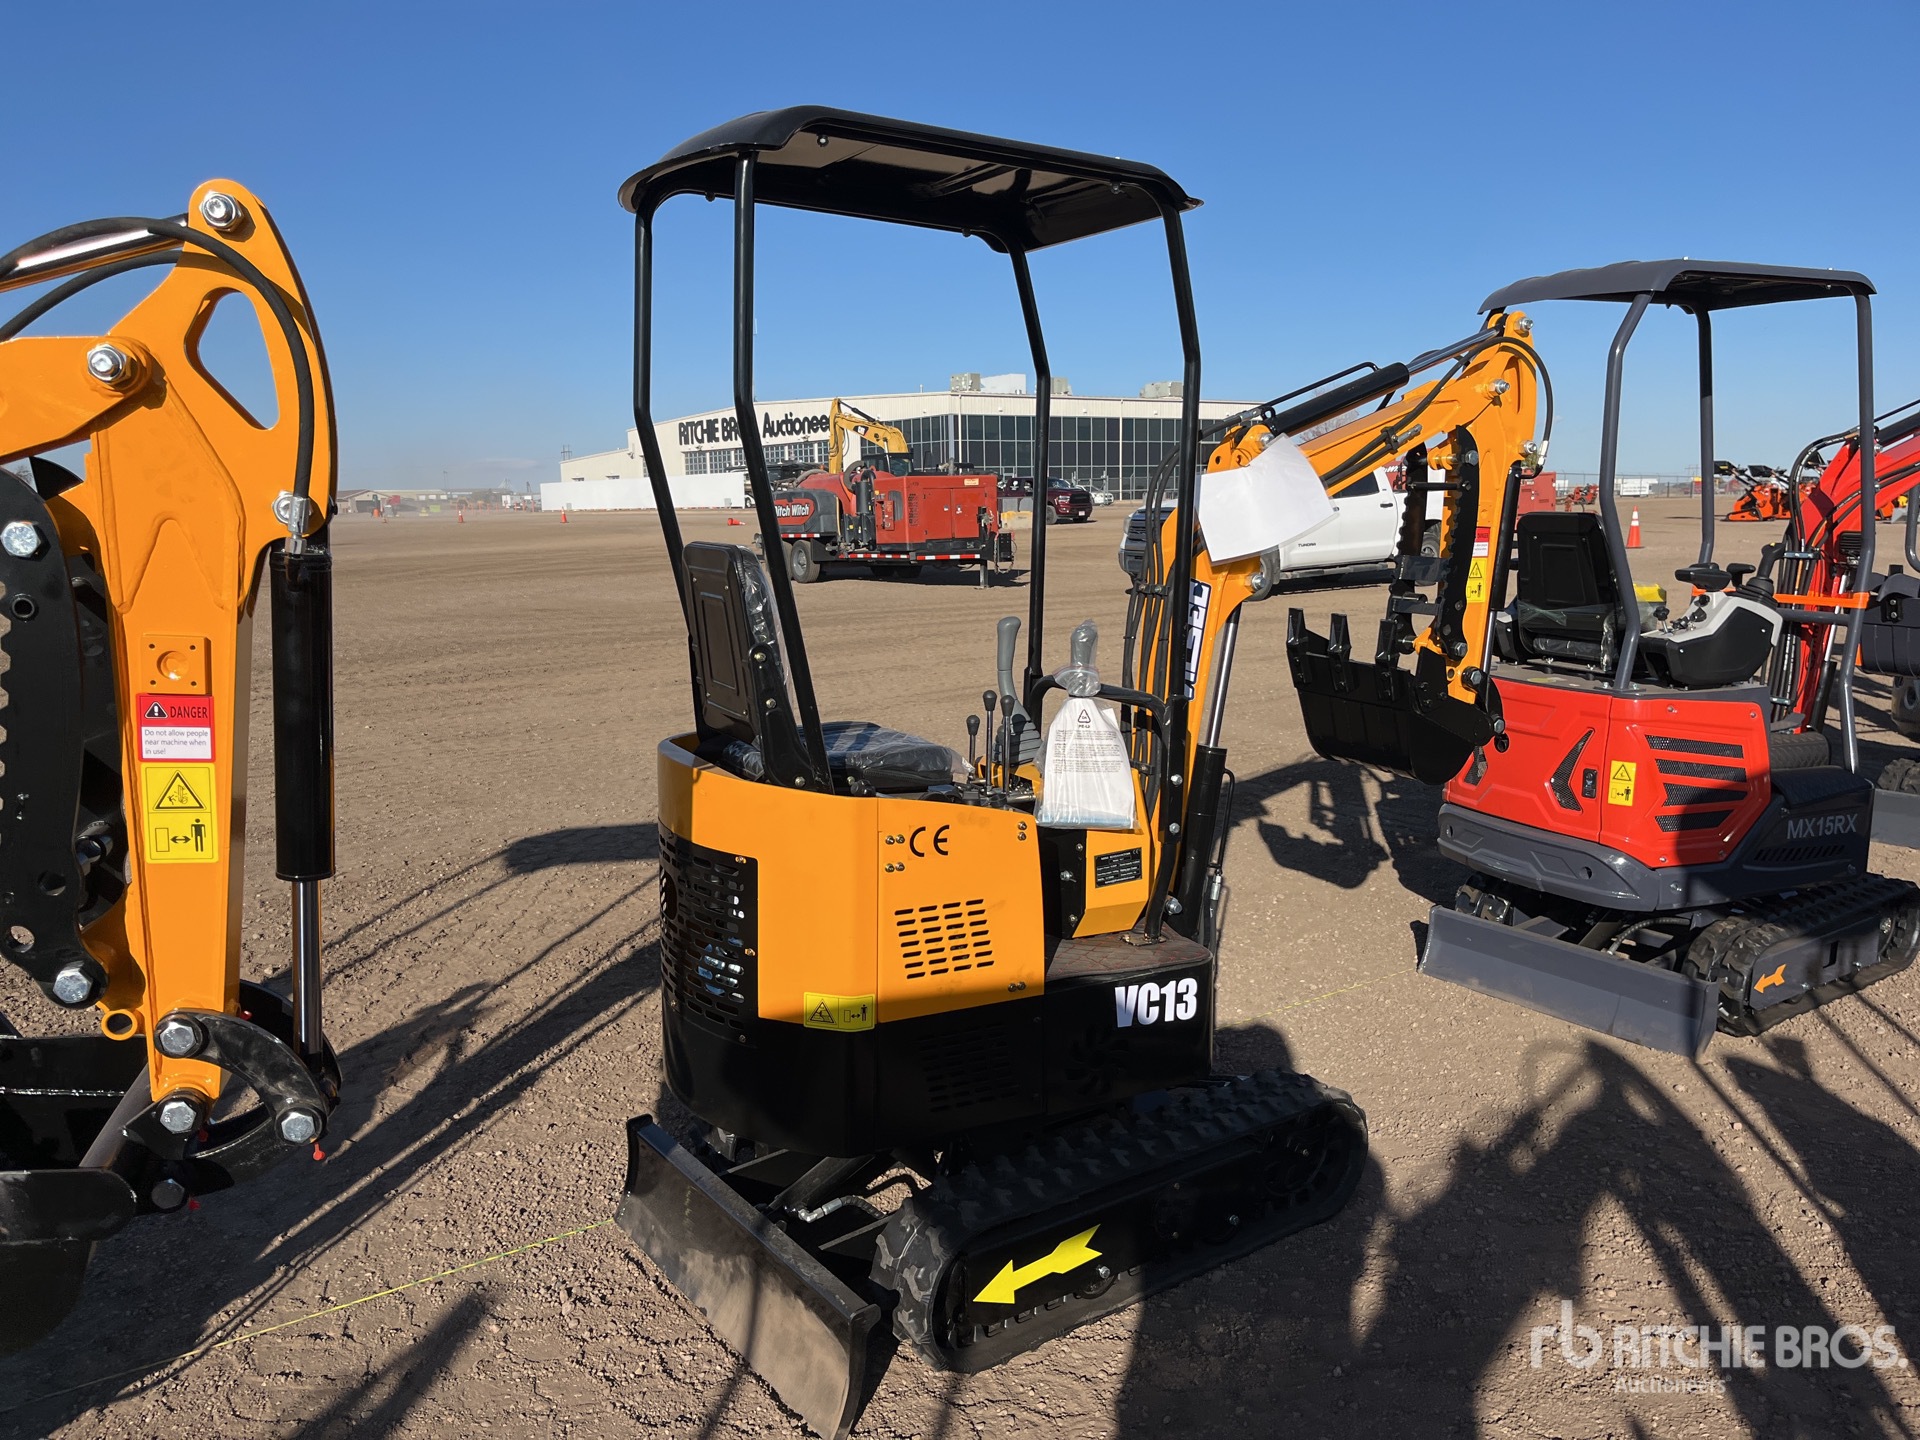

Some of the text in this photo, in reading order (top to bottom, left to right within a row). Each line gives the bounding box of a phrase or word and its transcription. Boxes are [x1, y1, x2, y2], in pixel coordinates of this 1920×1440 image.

[679, 418, 720, 446] RITCHIE
[762, 411, 831, 438] Auctionee
[791, 503, 810, 516] Witch
[170, 706, 208, 718] DANGER
[186, 729, 209, 738] people
[1787, 813, 1858, 840] MX15RX
[909, 824, 950, 858] CE
[1115, 977, 1198, 1028] VC13
